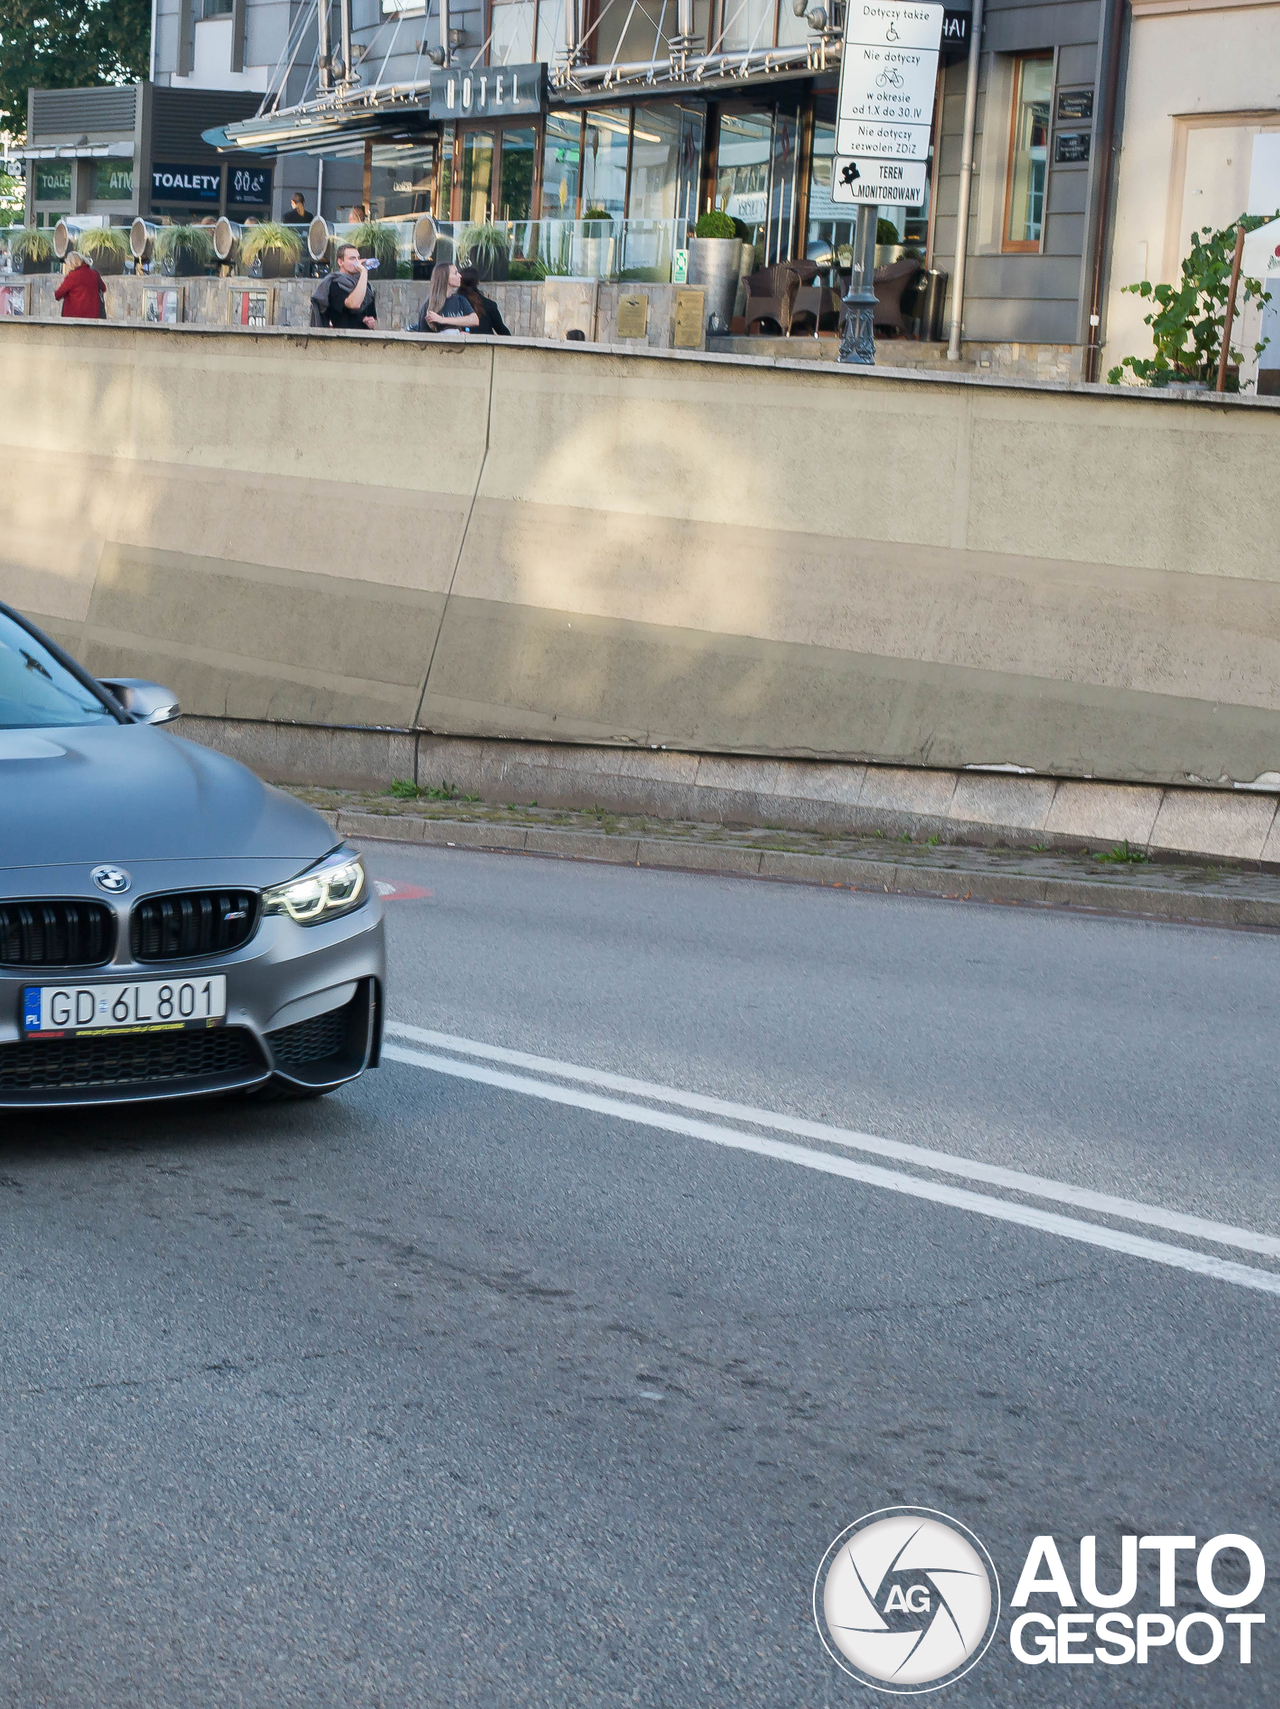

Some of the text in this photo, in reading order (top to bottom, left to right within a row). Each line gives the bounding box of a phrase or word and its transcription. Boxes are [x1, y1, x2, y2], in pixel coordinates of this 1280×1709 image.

[863, 5, 930, 21] Dotyczy także
[863, 49, 921, 66] Nie dotyczy
[446, 73, 520, 109] HOTEL
[866, 91, 911, 103] w okresie
[852, 105, 865, 114] od
[882, 106, 895, 117] do
[898, 107, 922, 119] 30.IV
[858, 125, 913, 142] Nie dotyczy
[896, 143, 917, 155] ZDiZ
[879, 165, 904, 180] TEREN
[152, 172, 220, 190] TOALETY
[858, 184, 921, 202] MONITOROWANY
[50, 980, 213, 1026] GD 6L801
[25, 1014, 41, 1026] PL
